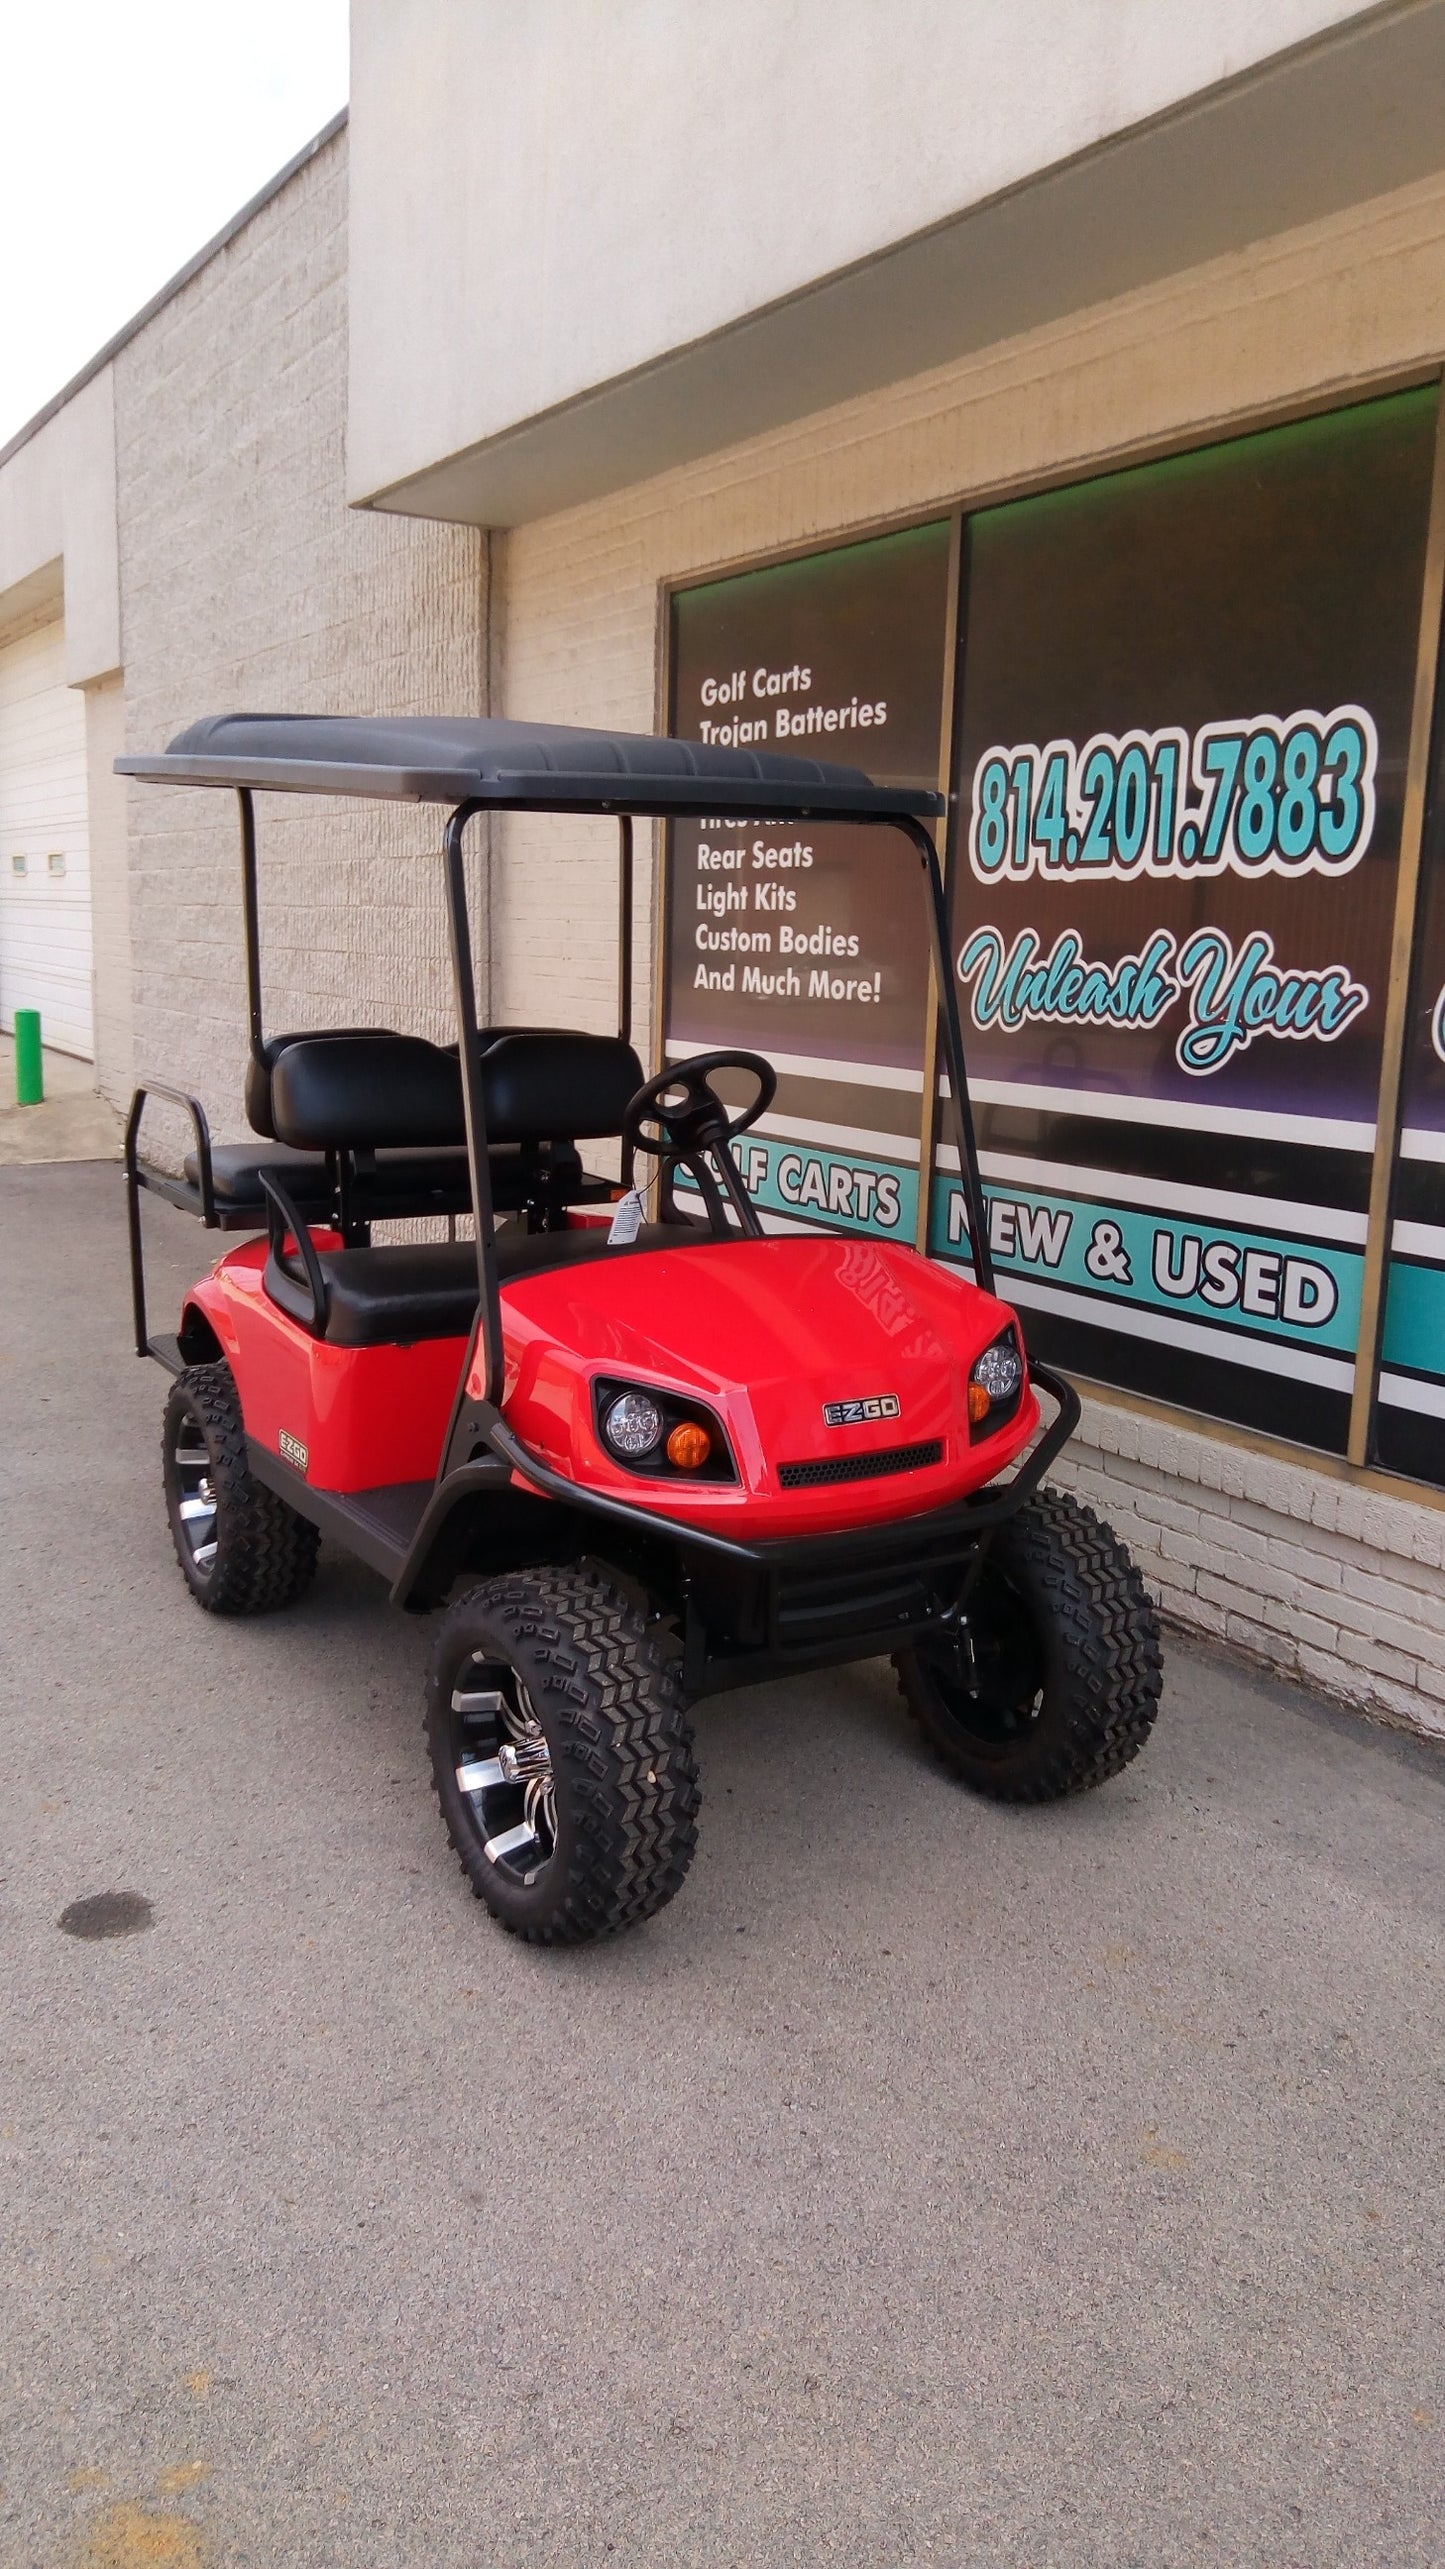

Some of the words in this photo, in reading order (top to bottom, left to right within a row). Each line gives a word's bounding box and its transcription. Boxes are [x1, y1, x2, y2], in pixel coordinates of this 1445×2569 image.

[700, 670, 747, 707] Golf
[752, 664, 812, 698] Carts
[699, 715, 768, 748] Trojan
[775, 696, 887, 738] Batteries
[974, 717, 1365, 874] 814.201.7883
[697, 843, 747, 870] Rear
[751, 840, 814, 869] Seats
[695, 881, 749, 918] Light
[754, 882, 797, 912] Kits
[694, 922, 772, 953] Custom
[778, 924, 860, 957] Bodies
[692, 962, 736, 992] And
[740, 965, 801, 997] Much
[807, 969, 882, 1004] More!
[960, 930, 1177, 1028] Unleash
[1180, 932, 1363, 1071] Your
[777, 1154, 901, 1228] CARTS
[1086, 1220, 1132, 1284] &
[1153, 1230, 1338, 1327] USED
